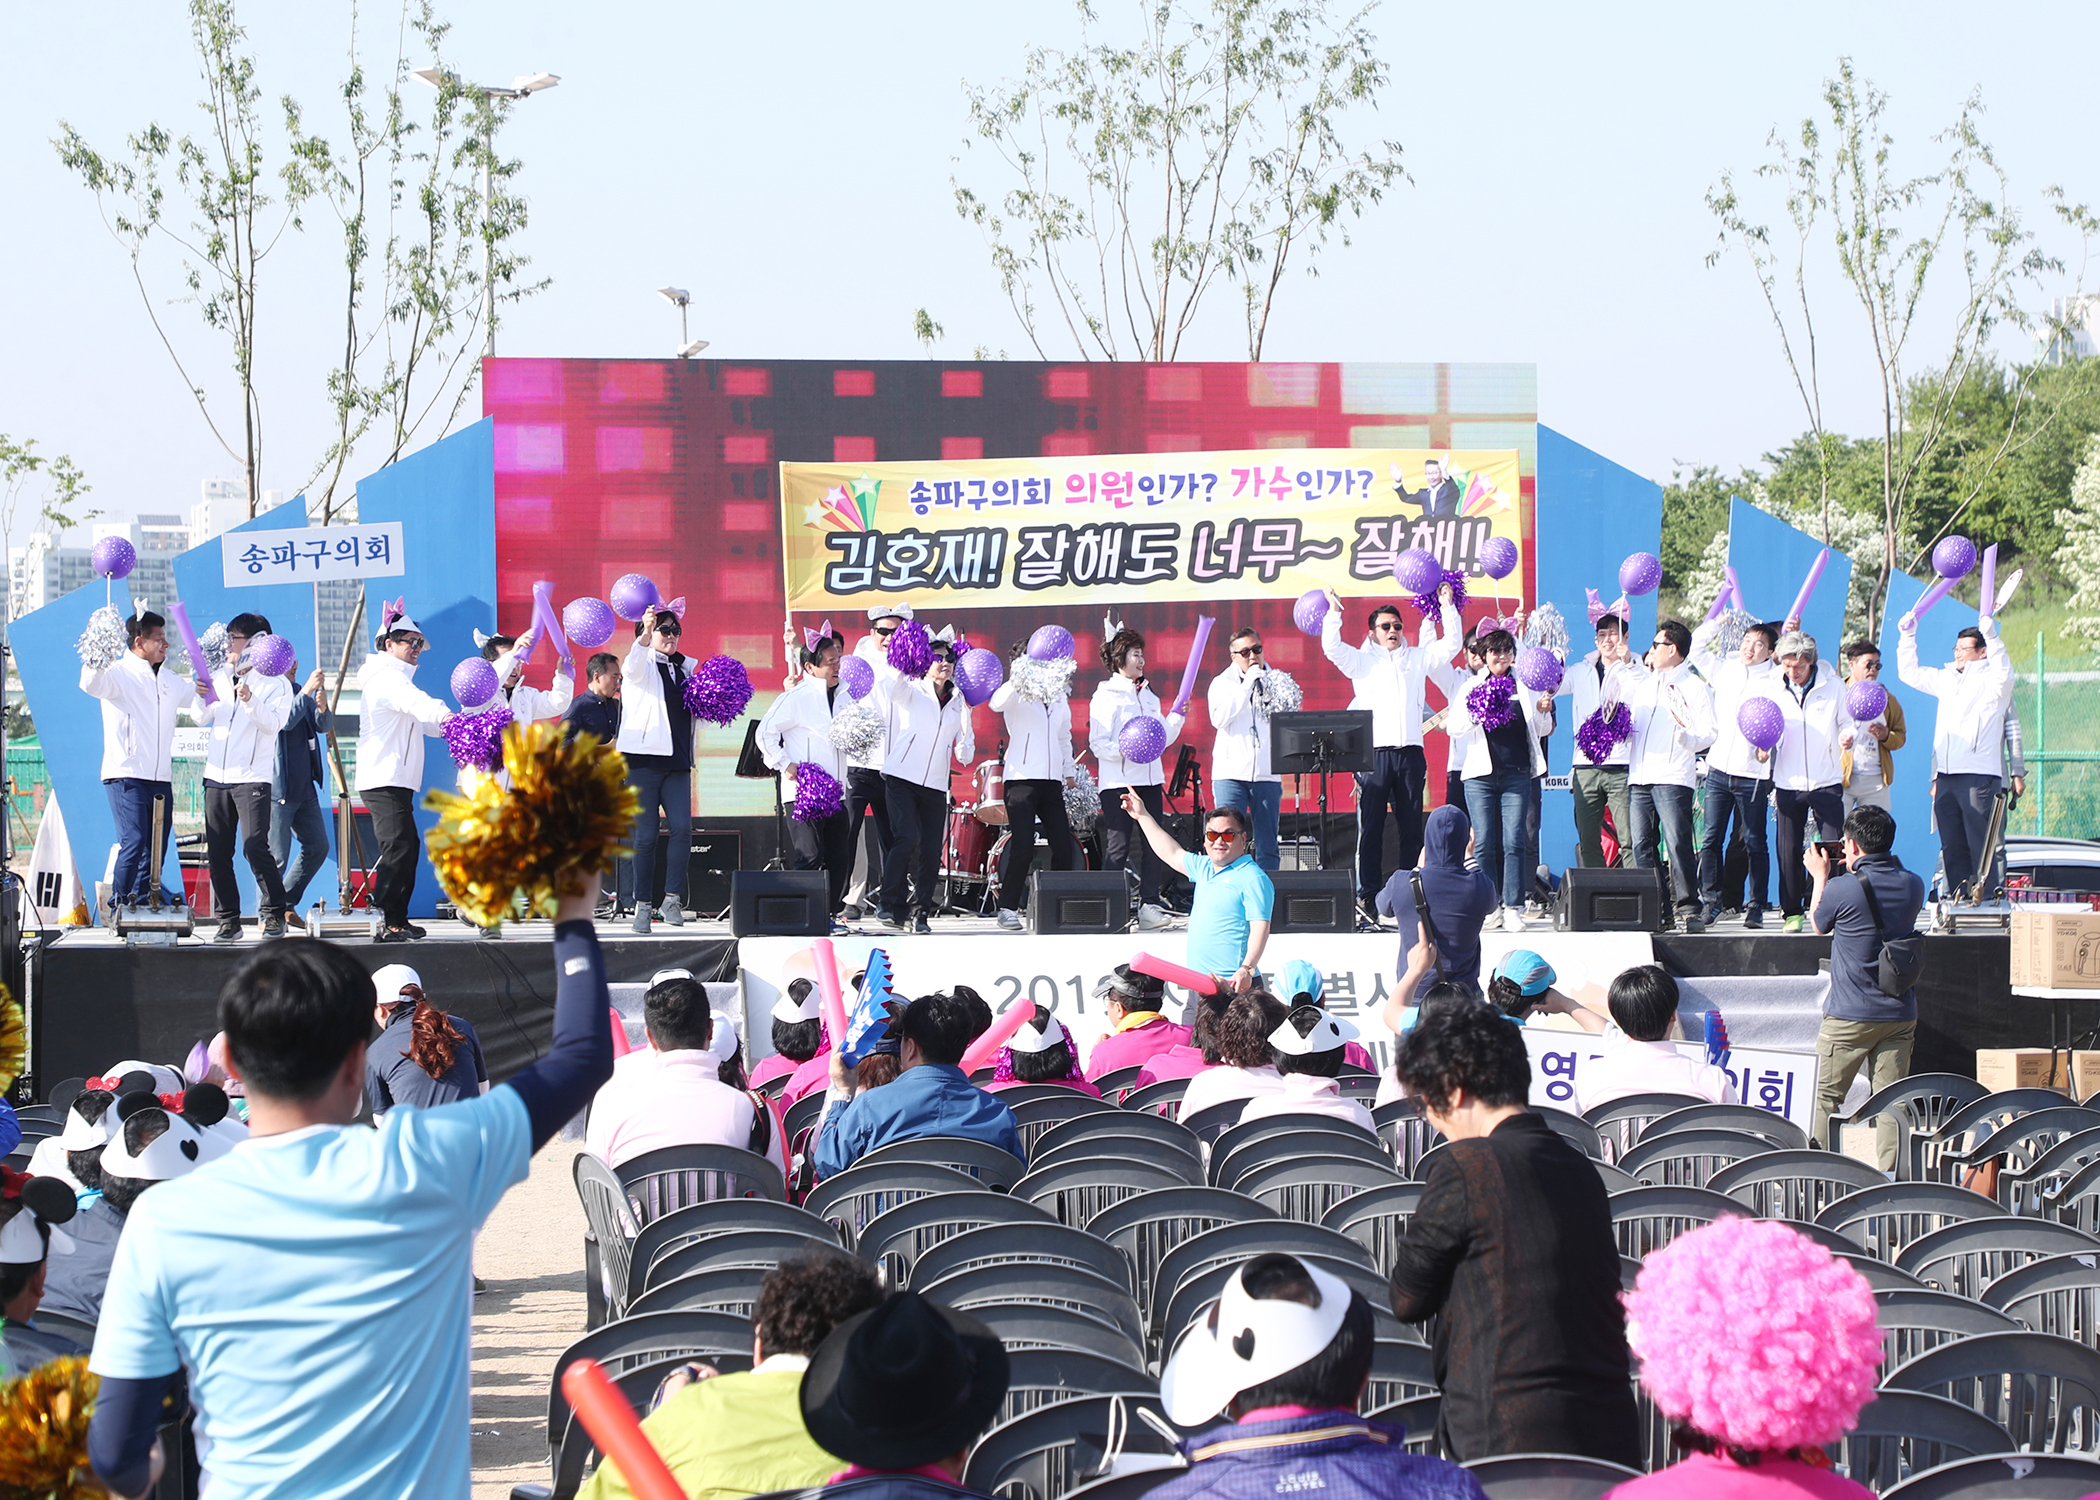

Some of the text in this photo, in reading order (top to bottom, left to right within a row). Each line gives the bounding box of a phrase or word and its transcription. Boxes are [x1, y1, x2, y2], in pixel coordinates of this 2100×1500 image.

[910, 466, 1373, 515] 송파구의회 의원인가? 가수인가?
[239, 534, 390, 574] 송파구의회
[829, 532, 1003, 590] 김호재!
[1018, 527, 1176, 585] 잘해도
[1354, 520, 1487, 576] 잘해!!
[1545, 778, 1569, 786] KORG
[994, 975, 1113, 1015] 201
[1275, 1478, 1326, 1493] CASTEL
[1279, 1470, 1319, 1485] LOUIS
